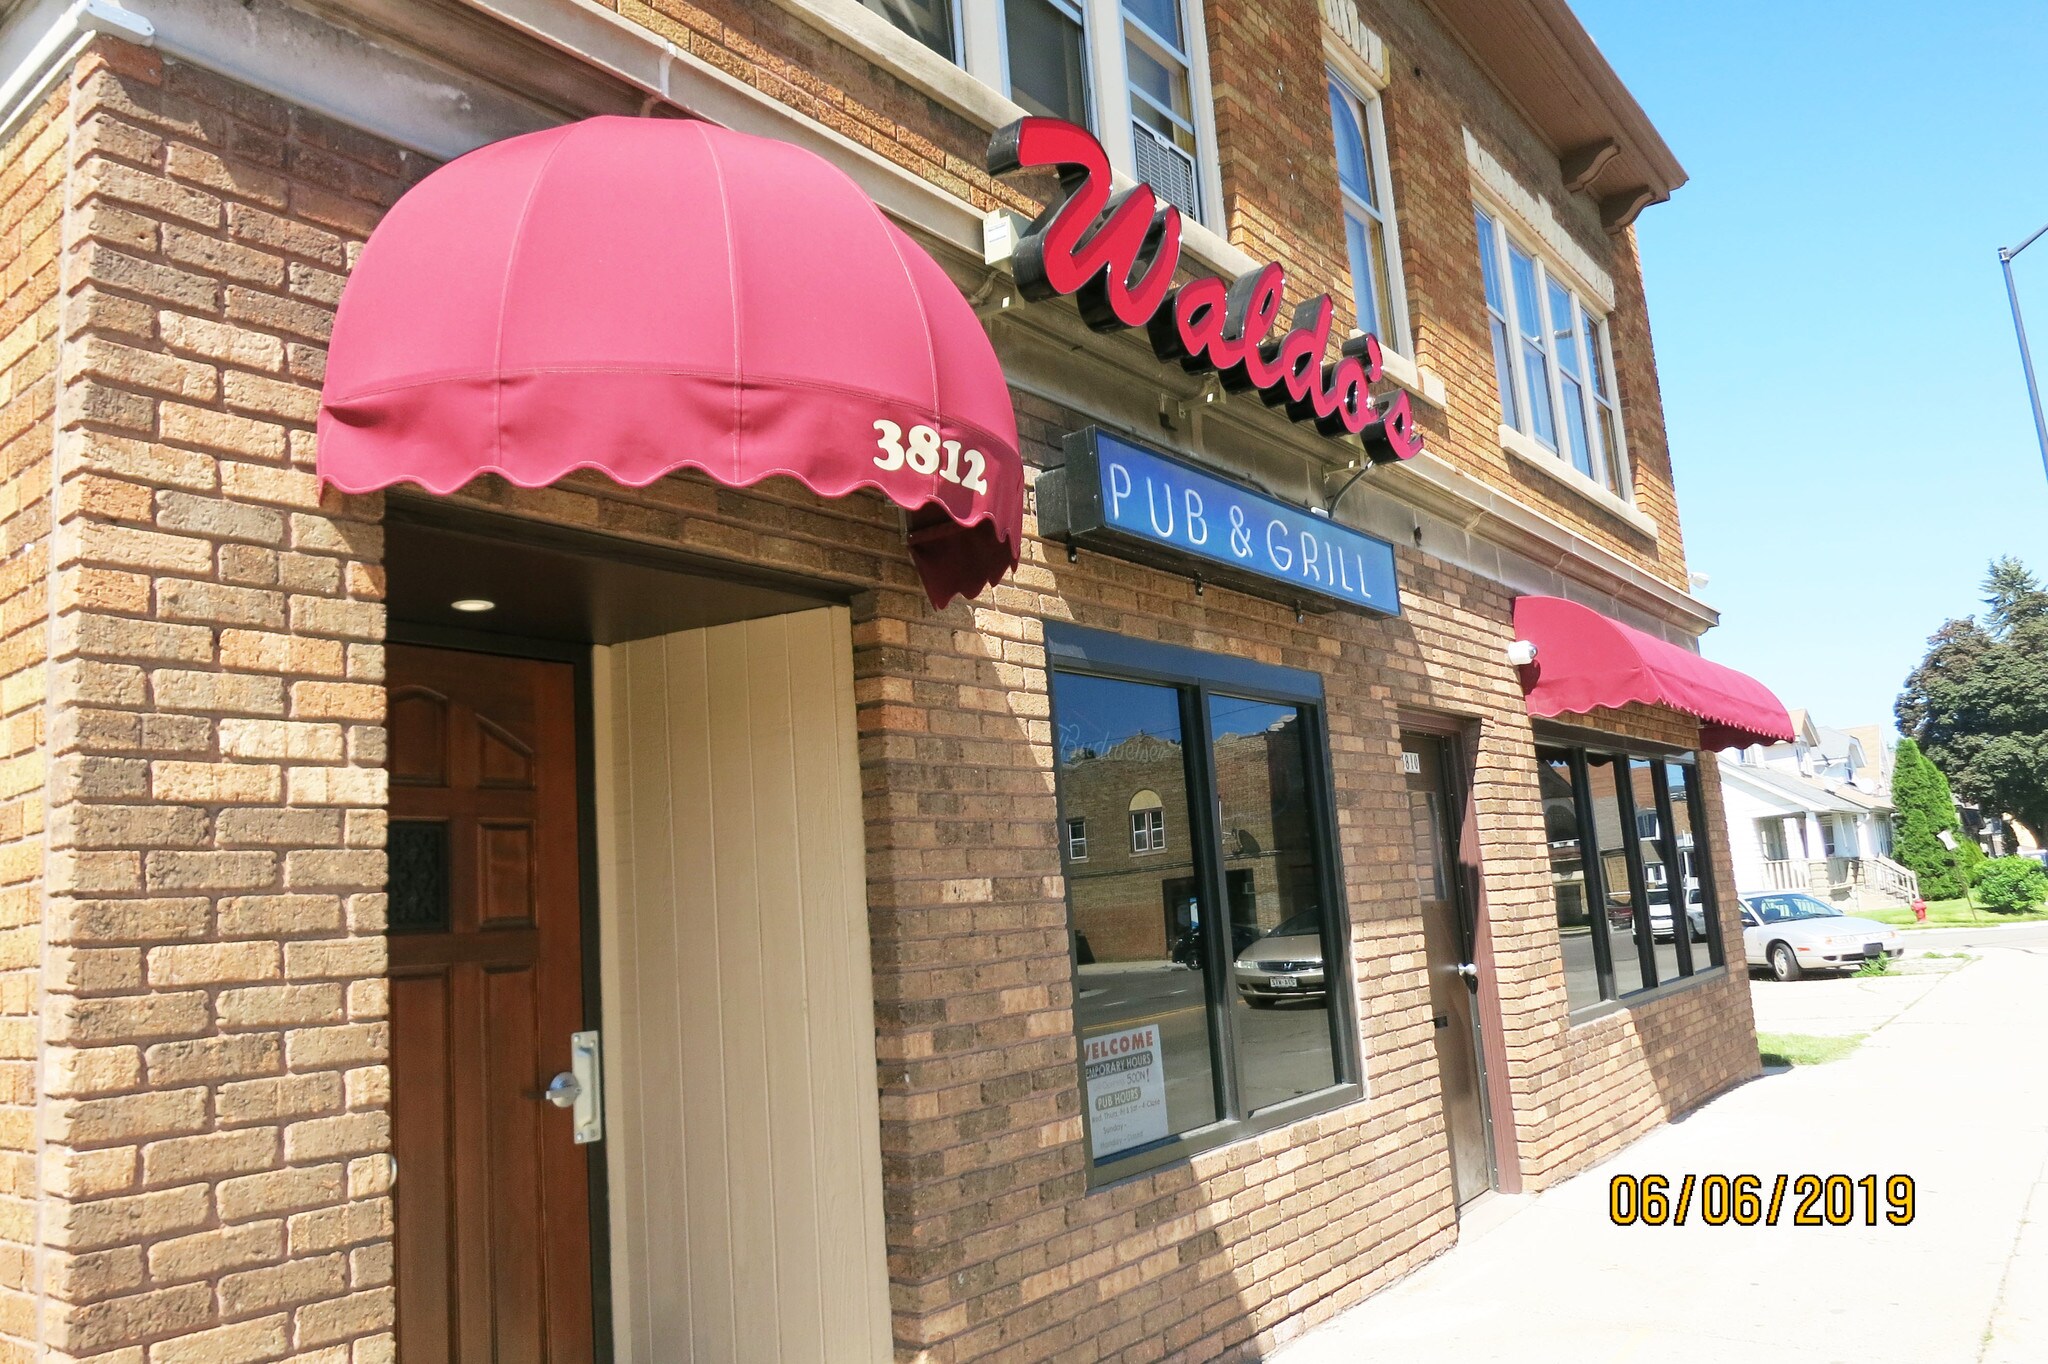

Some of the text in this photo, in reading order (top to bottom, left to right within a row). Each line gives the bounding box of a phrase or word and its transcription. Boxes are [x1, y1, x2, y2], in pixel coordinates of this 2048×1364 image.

[992, 115, 1424, 461] Waldo's
[872, 419, 988, 496] 3812
[1109, 462, 1372, 599] PUB & GRILL
[1401, 754, 1419, 770] 810
[1126, 1053, 1151, 1069] HOURS
[1097, 1087, 1139, 1109] PUB HOURS
